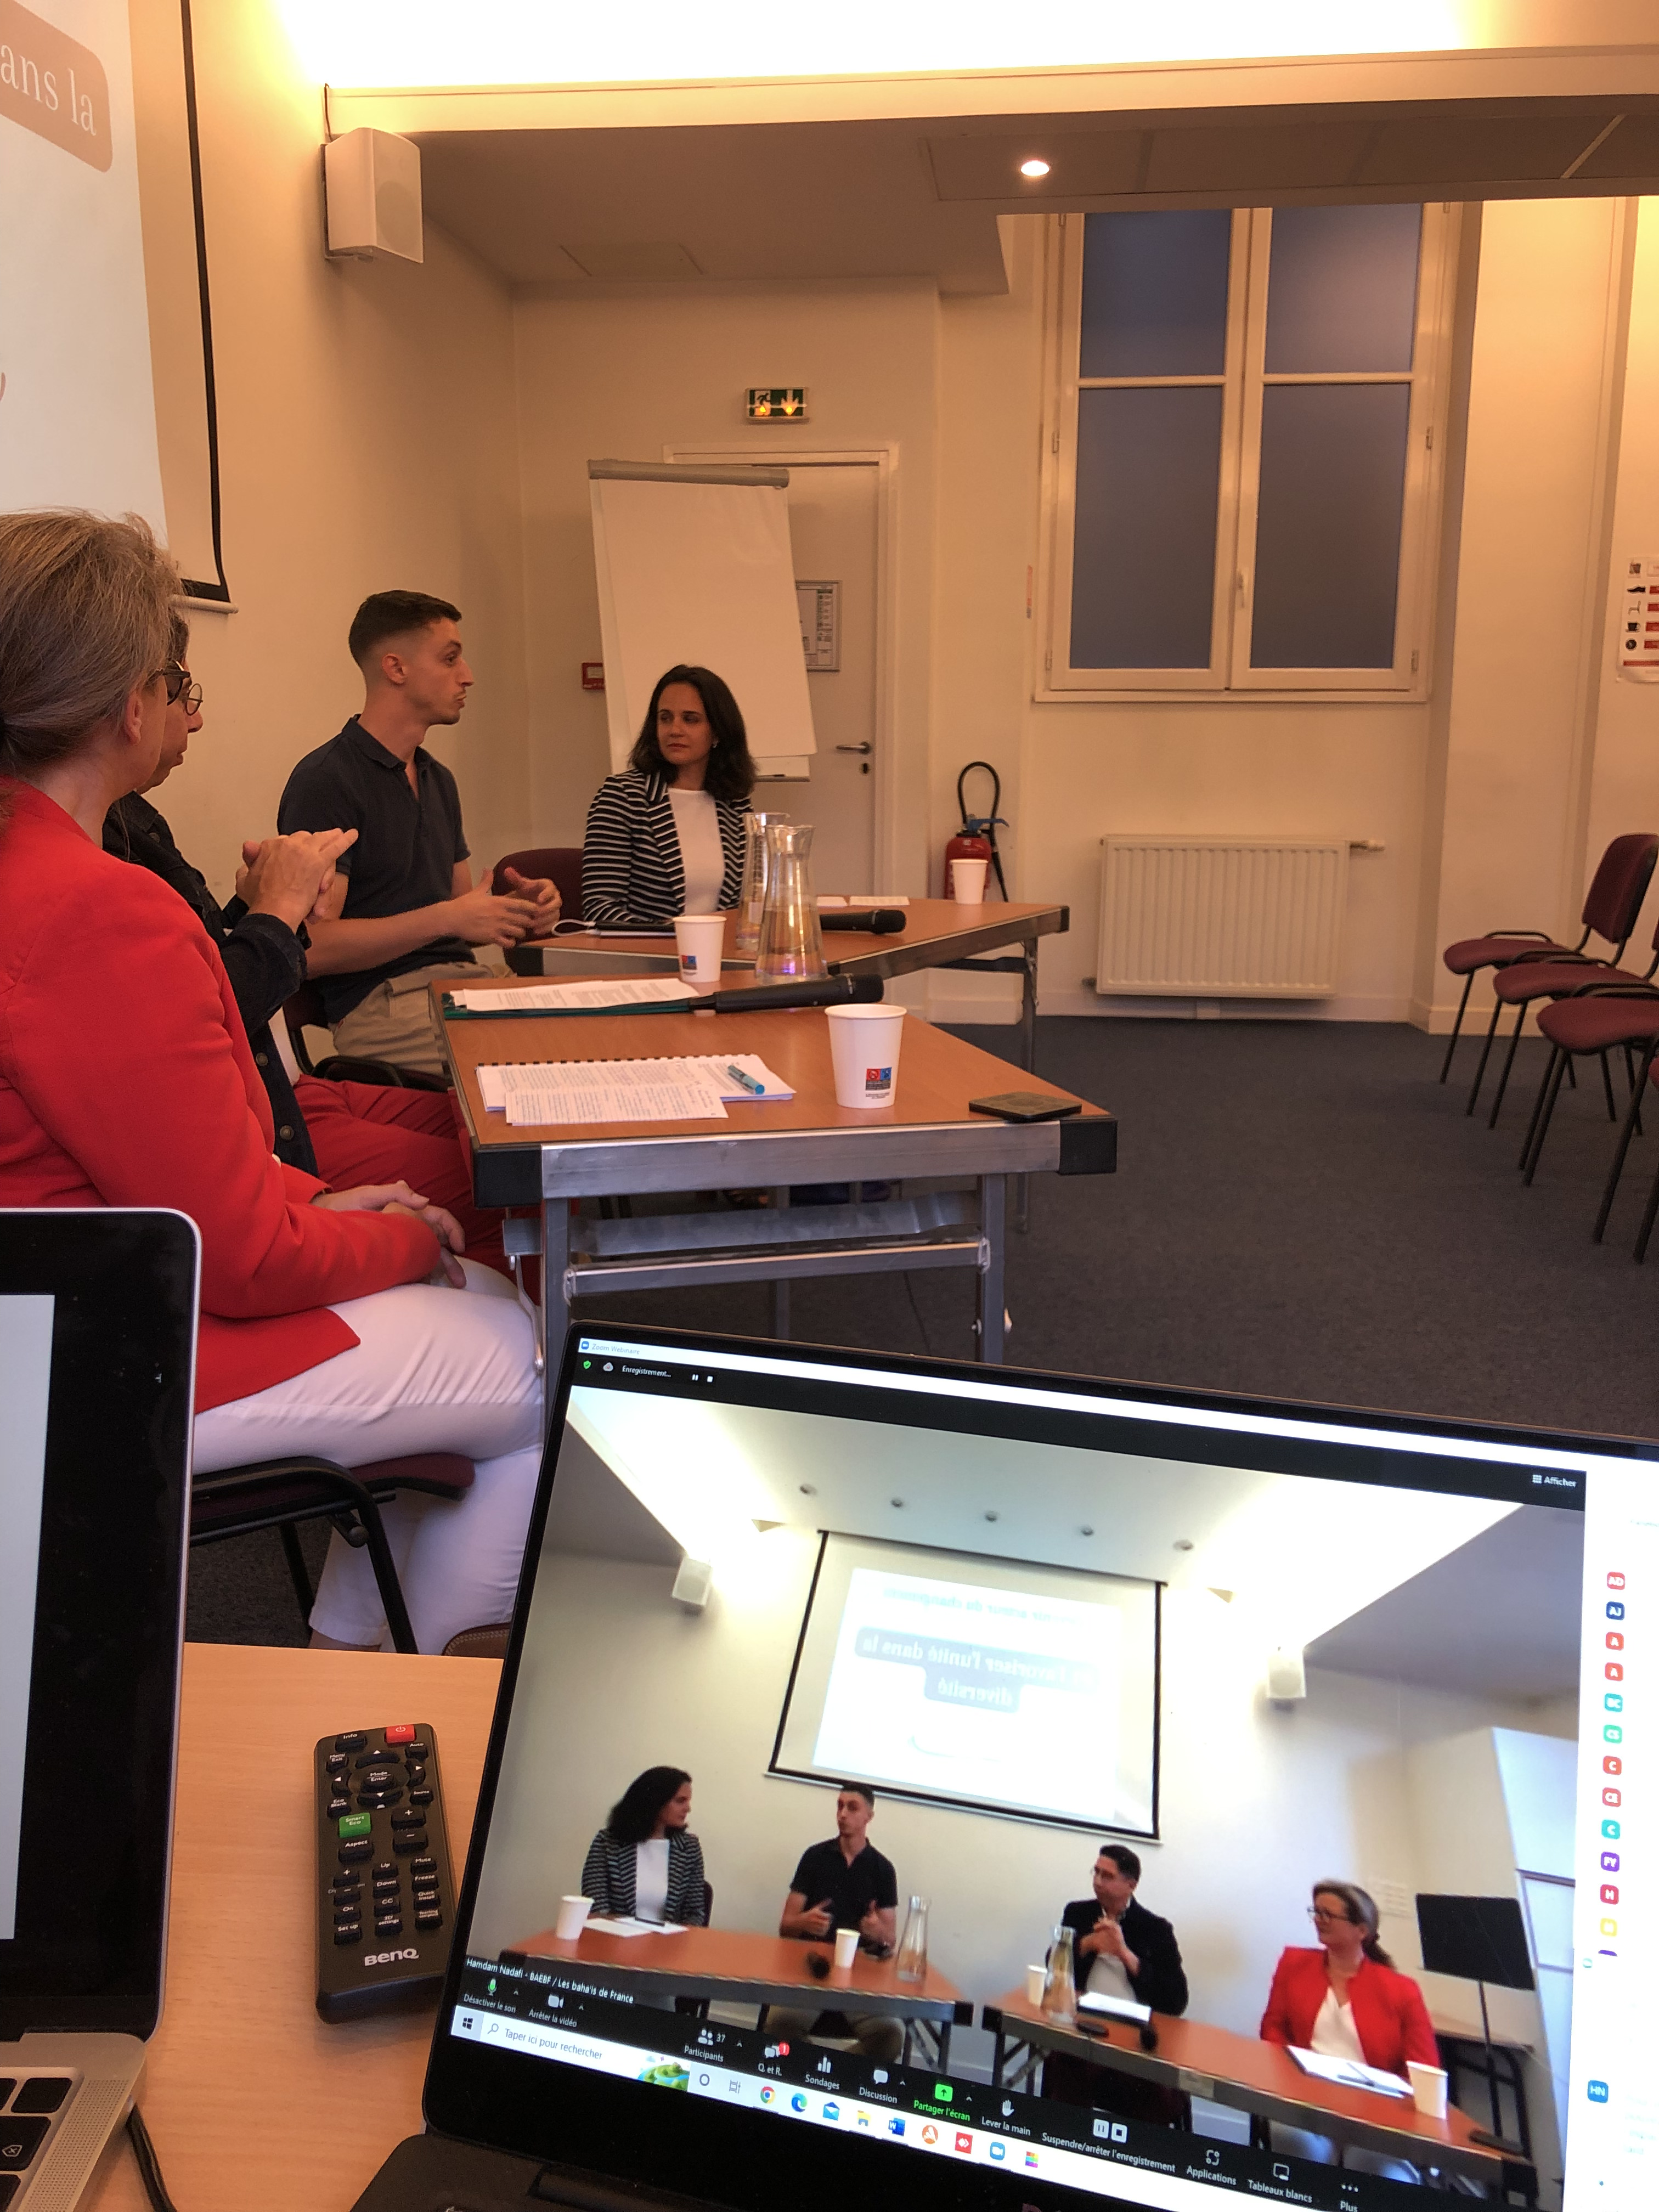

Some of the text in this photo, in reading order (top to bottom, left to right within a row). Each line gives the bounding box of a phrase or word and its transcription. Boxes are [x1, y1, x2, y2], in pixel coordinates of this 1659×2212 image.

[67, 67, 97, 136] la
[592, 1343, 640, 1355] Zoom Webinaire
[1544, 1476, 1577, 1487] Afficher
[364, 1948, 419, 1966] BenQ
[466, 1959, 498, 1973] Hamdam
[499, 1964, 523, 1978] Nadafi
[529, 1971, 552, 1984] BAEBF
[558, 1977, 569, 1989] Les
[599, 1987, 608, 1998] de
[610, 1989, 634, 2004] France
[464, 1993, 516, 2013] Désactiver le son
[528, 2008, 578, 2028] Arrêter la vidéo
[505, 2028, 603, 2059] Taper ici pour rechercher
[716, 2033, 726, 2043] 37
[684, 2045, 724, 2062] Participants
[767, 2066, 775, 2074] et
[805, 2074, 840, 2090] Sondages
[1590, 2085, 1605, 2096] HN
[859, 2086, 898, 2104] Discussion
[913, 2099, 970, 2121] Partager l'écran
[981, 2116, 1031, 2136] Lever la main
[1042, 2132, 1176, 2173] Suspendre/arrêter l'enregistrement
[1186, 2165, 1237, 2186] Applications
[1248, 2179, 1313, 2203] Tableaux blancs
[1340, 2200, 1358, 2212] Plus
